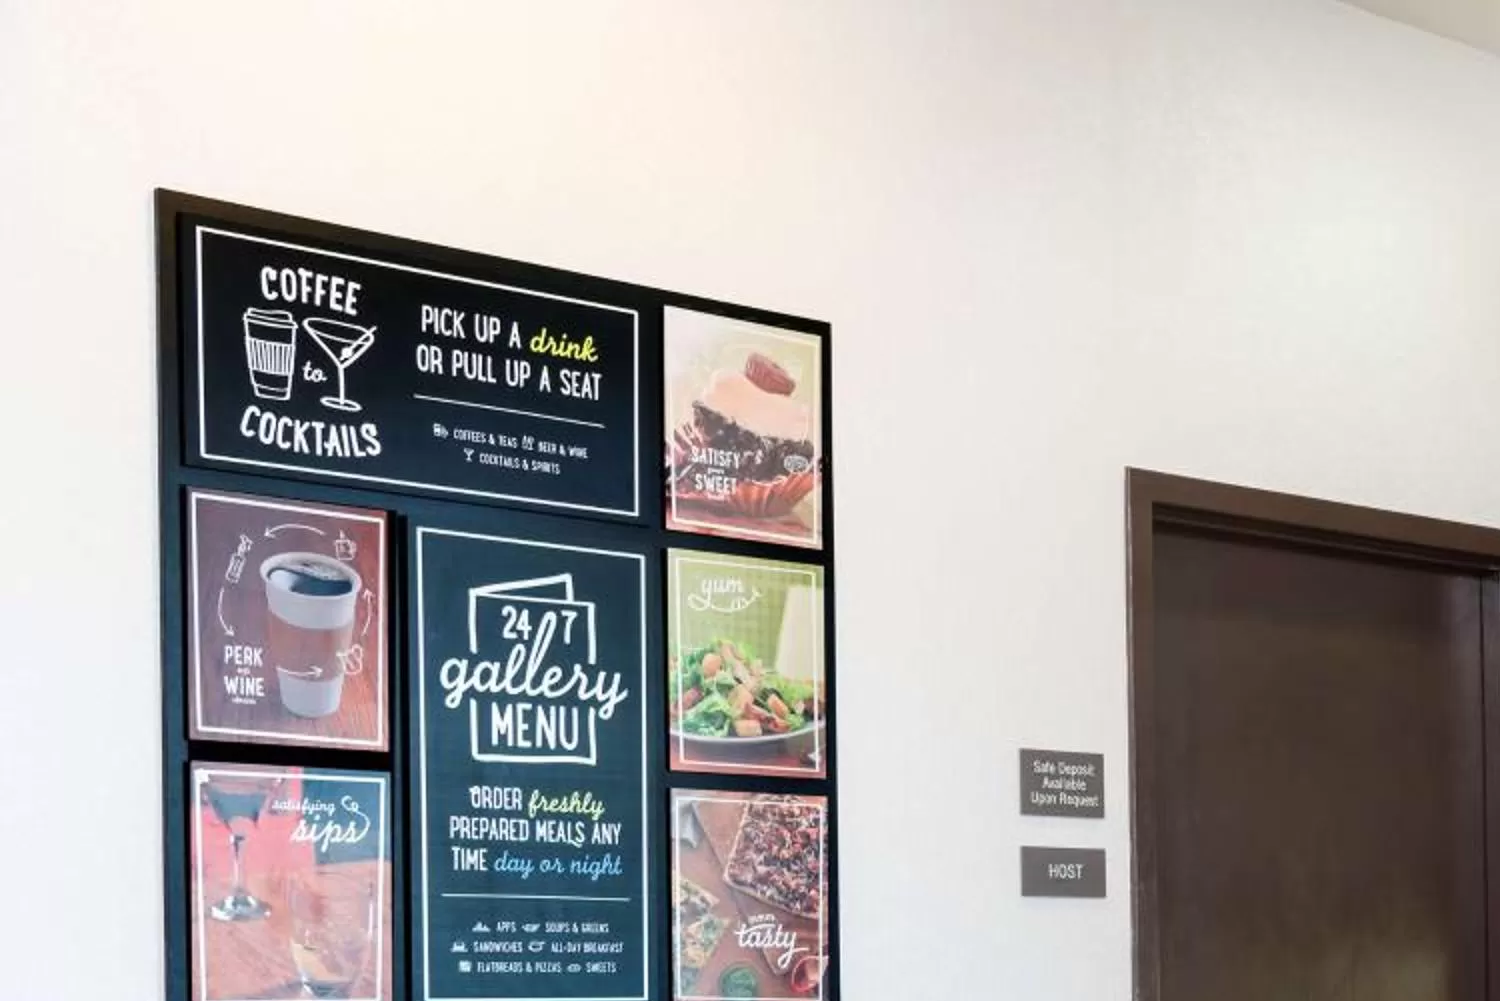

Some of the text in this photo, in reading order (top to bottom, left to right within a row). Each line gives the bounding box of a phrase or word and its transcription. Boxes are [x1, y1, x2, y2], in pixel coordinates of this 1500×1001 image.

[260, 265, 362, 317] COFFEE
[421, 304, 599, 363] PICK UP A drink
[302, 360, 329, 383] to
[416, 343, 603, 401] OR PULL UP A SEAT
[240, 405, 382, 457] COCKTAILS
[453, 428, 487, 444] COFFEES
[499, 435, 518, 449] TEAS
[538, 441, 558, 455] BEER
[568, 446, 589, 460] WINE
[479, 453, 520, 470] COCKTAILS
[531, 460, 561, 475] SPIRITS
[691, 445, 740, 469] SATISFY
[695, 473, 737, 495] SWEET
[501, 604, 578, 644] 24 7
[223, 644, 264, 668] PERK
[440, 611, 629, 721] gallery
[223, 675, 266, 697] WINE
[491, 701, 579, 750] MENU
[1033, 760, 1096, 777] Safe Deposit
[1042, 776, 1087, 790] Available
[271, 797, 336, 816] satisfying
[469, 785, 606, 820] ORDER freshly
[1031, 791, 1057, 806] Upon
[289, 813, 370, 853] sips
[450, 815, 622, 848] PREPARED MEALS ANY
[451, 846, 624, 881] TIME day or night
[1048, 863, 1085, 880] HOST
[495, 920, 517, 933] APPS
[545, 921, 570, 934] SOUPS
[473, 940, 524, 953] SANDWICHES
[735, 923, 809, 969] tasty
[586, 961, 617, 973] SWEETS
